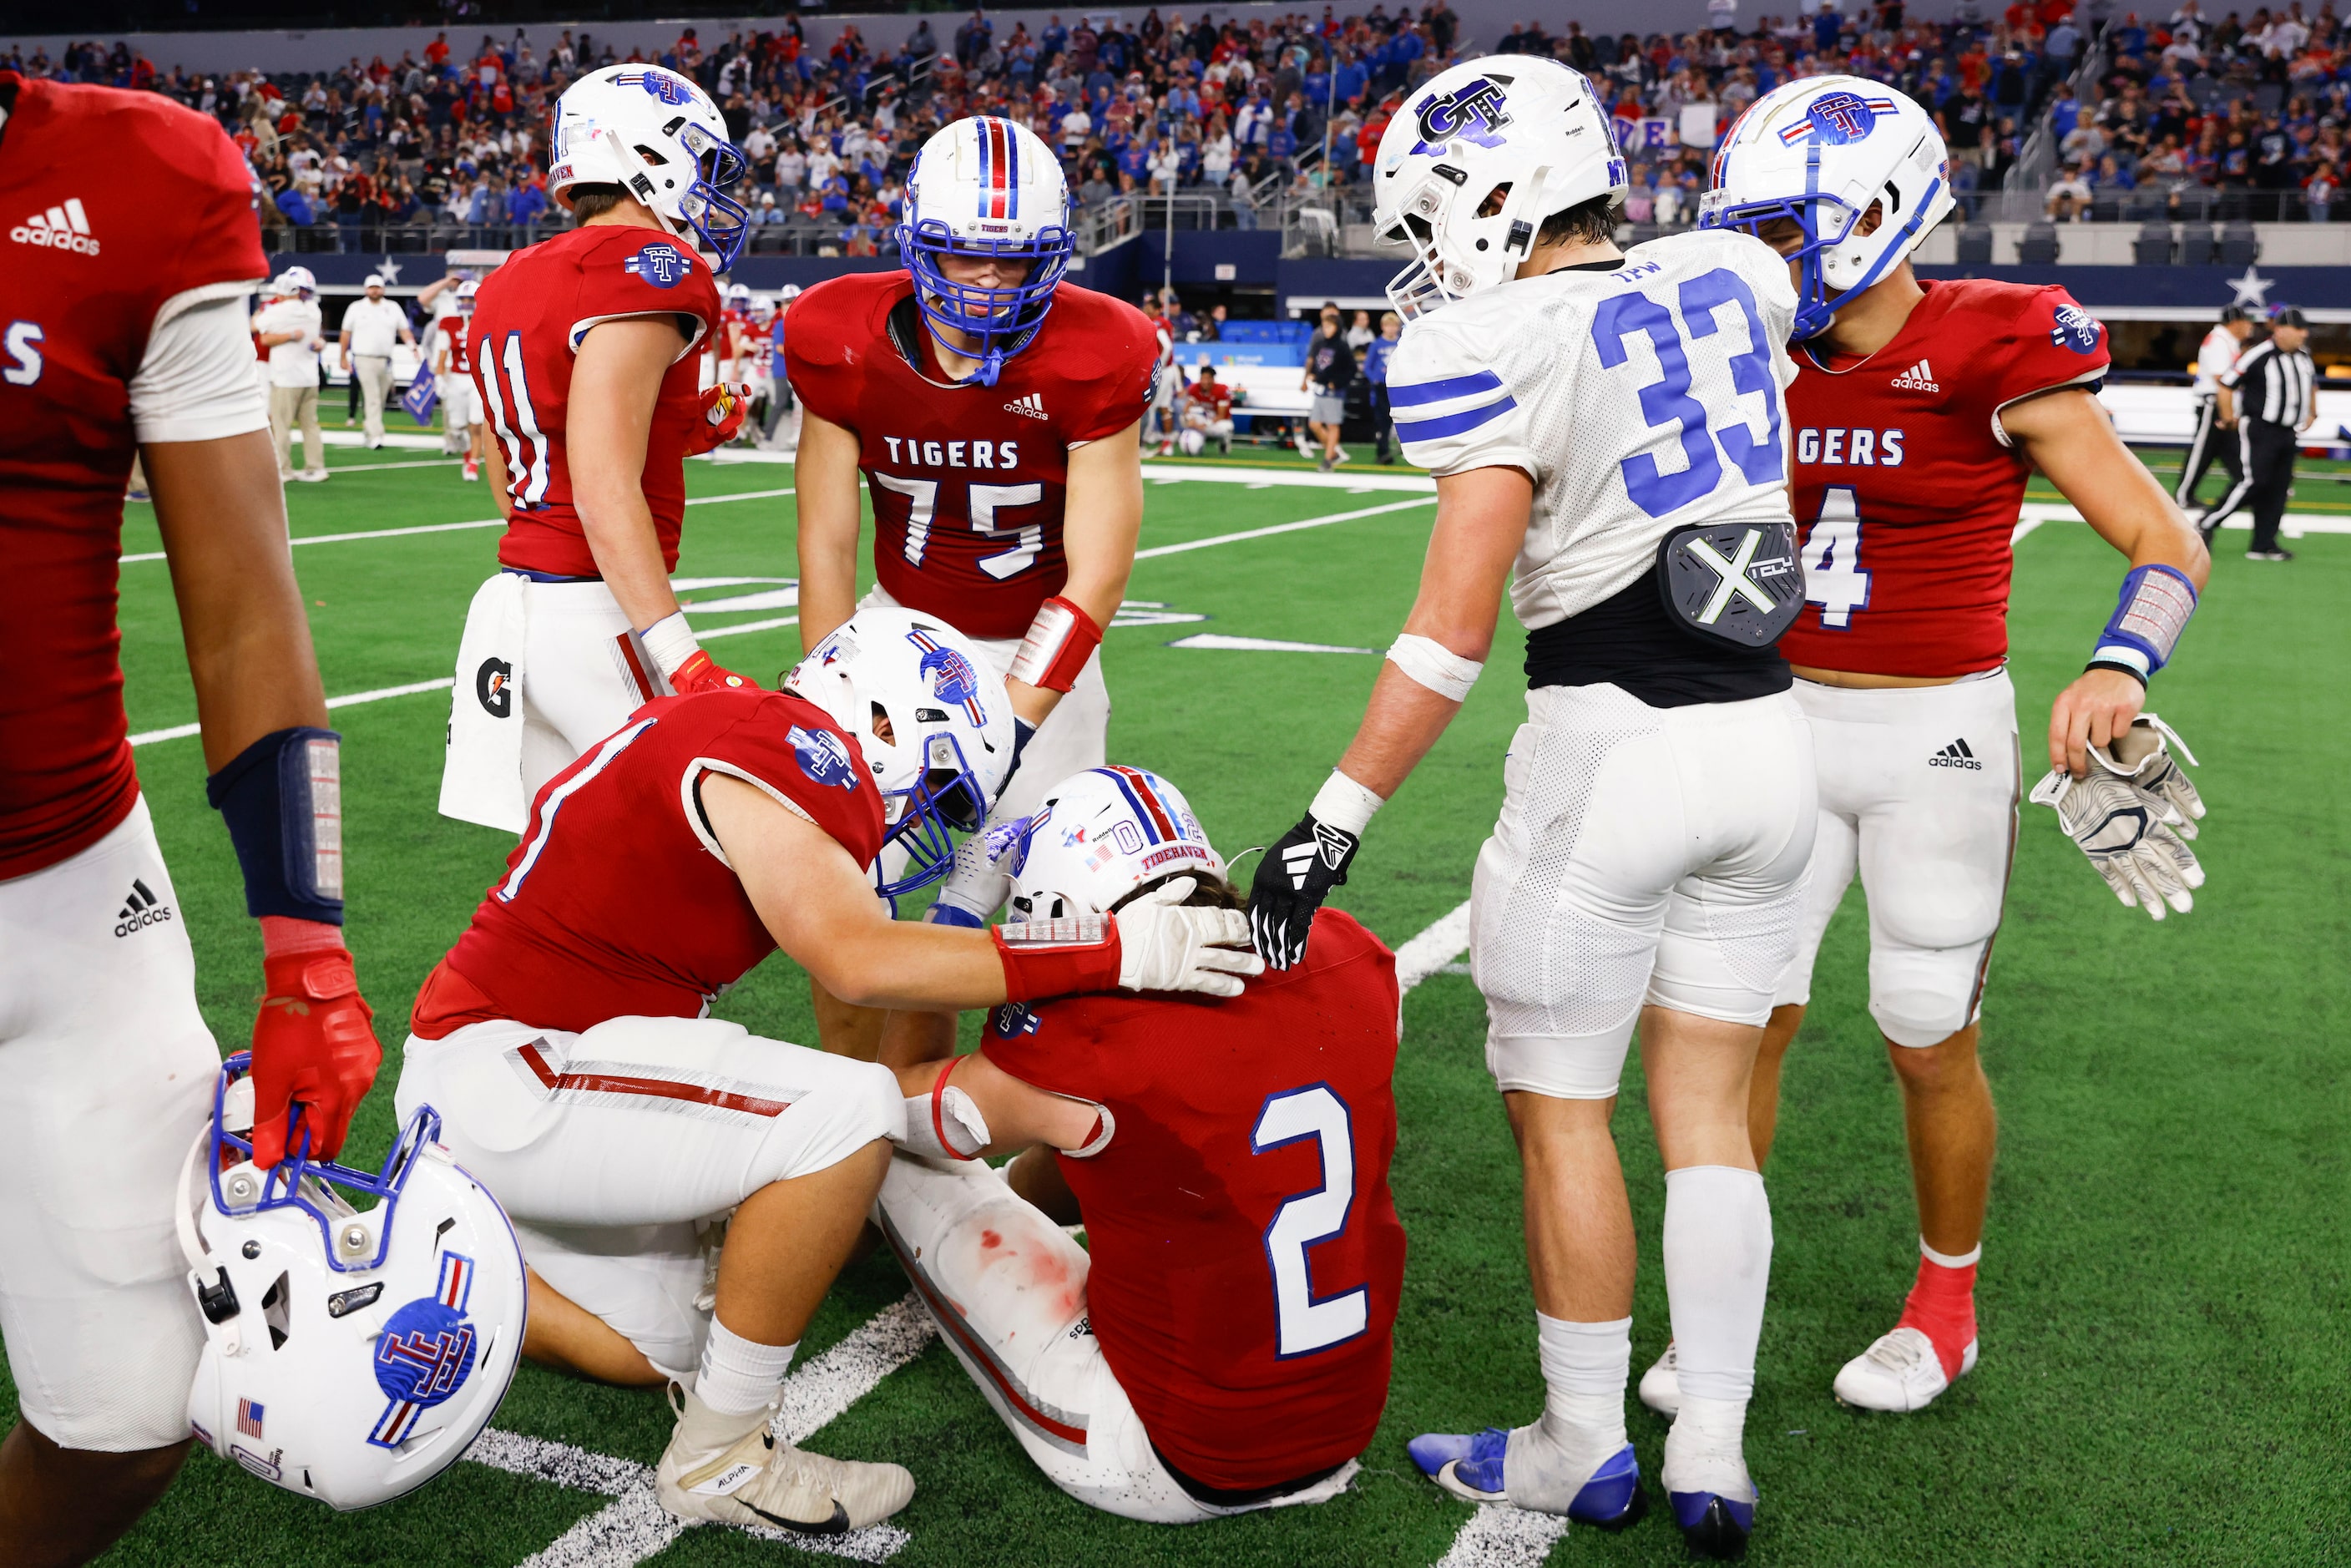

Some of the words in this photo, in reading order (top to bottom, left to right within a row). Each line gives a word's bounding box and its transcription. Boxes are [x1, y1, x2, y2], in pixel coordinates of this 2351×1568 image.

[10, 225, 100, 256] adidas
[980, 224, 1009, 233] TIGERS
[1610, 261, 1661, 283] TPW
[3, 319, 45, 387] S
[1590, 268, 1784, 518] 33
[1890, 377, 1940, 393] adidas
[478, 330, 552, 511] 11
[1003, 402, 1049, 422] adidas
[882, 434, 1020, 470] TIGERS
[1792, 427, 1906, 468] GERS
[872, 470, 1047, 582] 75
[1800, 483, 1873, 631] 4
[476, 656, 512, 719] G
[1929, 755, 1982, 771] adidas
[1140, 844, 1209, 873] TIDEHAVEN
[114, 906, 172, 938] adidas
[1248, 1080, 1371, 1363] 2
[718, 1465, 751, 1490] ALPHA
